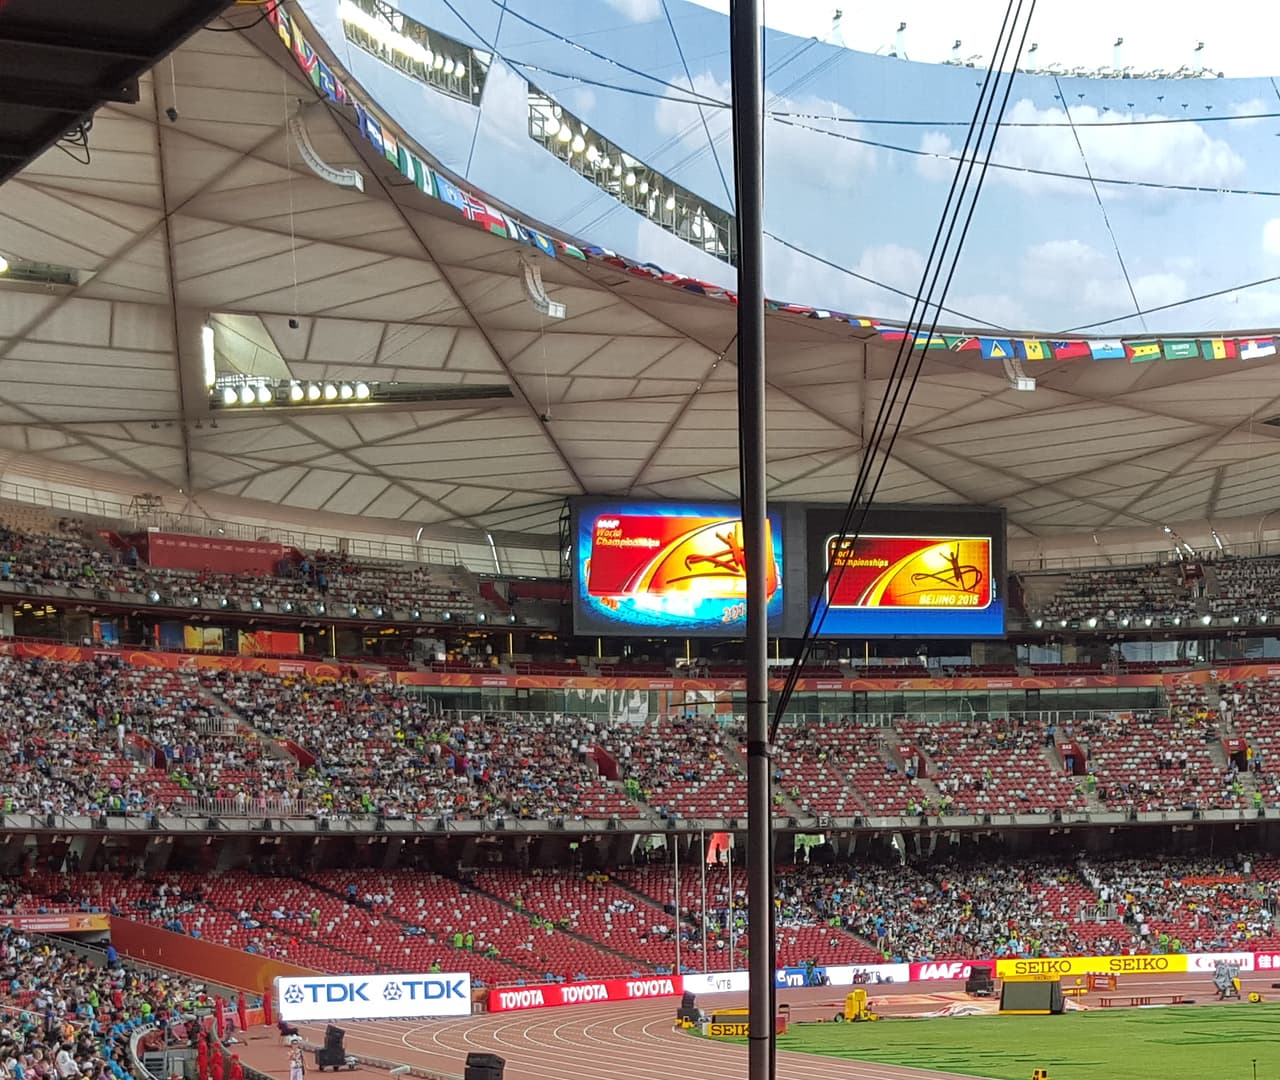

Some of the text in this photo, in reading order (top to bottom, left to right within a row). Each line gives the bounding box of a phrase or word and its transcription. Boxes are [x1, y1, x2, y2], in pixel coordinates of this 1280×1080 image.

[596, 528, 622, 537] World
[919, 594, 979, 606] BEIJING 2015
[1015, 960, 1072, 975] SEIKO
[1110, 957, 1169, 972] SEIKO
[627, 979, 674, 996] TOYOTA
[715, 979, 732, 990] VTB
[787, 974, 804, 986] VTB
[304, 982, 369, 1003] TDK
[402, 980, 466, 1000] TDK
[561, 984, 608, 1002] TOYOTA
[500, 990, 544, 1008] TOYOTA
[711, 1024, 750, 1036] SEIK
